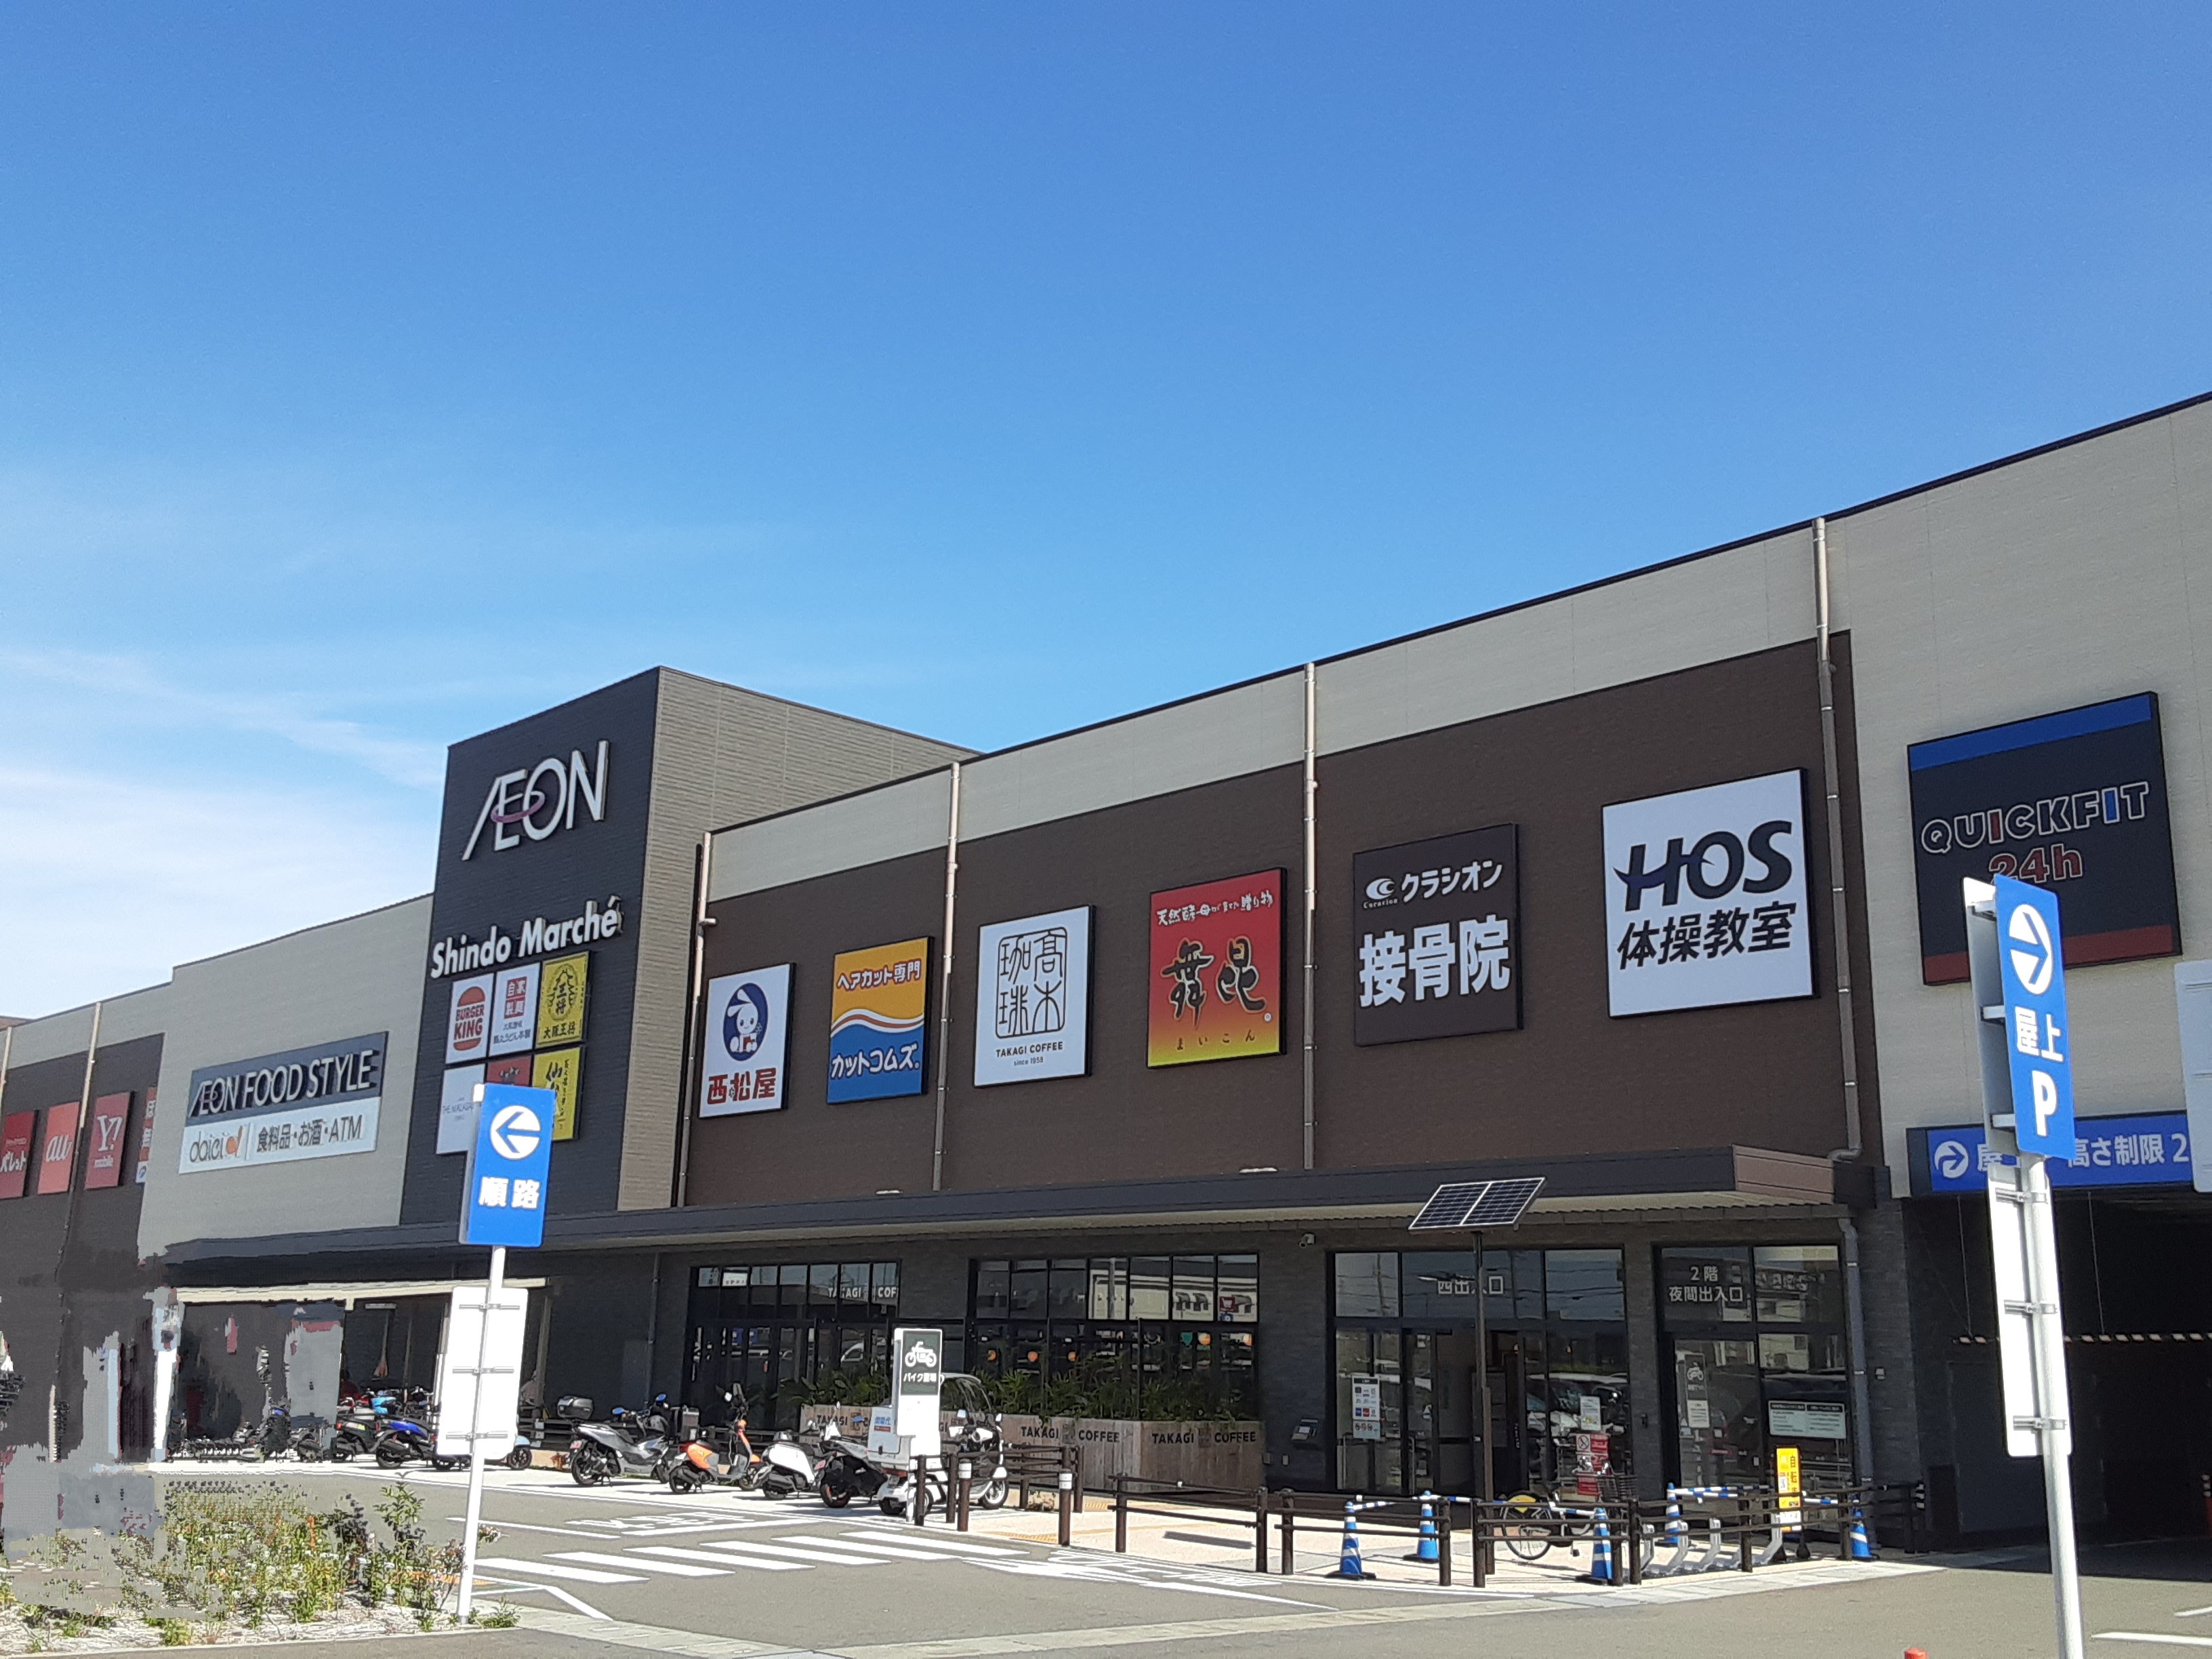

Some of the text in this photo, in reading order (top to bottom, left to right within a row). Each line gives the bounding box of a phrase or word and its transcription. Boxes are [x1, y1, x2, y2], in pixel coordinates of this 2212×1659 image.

[1921, 781, 2150, 854] QUICKFIT
[1401, 860, 1502, 903] クラシオン
[1612, 820, 1793, 912] HOS
[1988, 843, 2083, 885] 24h
[430, 895, 624, 977] Shindo Marché
[1617, 901, 1796, 970] 体操教室
[836, 960, 921, 990] ヘアカット専門
[1358, 915, 1511, 1008] 接骨院
[454, 1018, 483, 1040] KING
[543, 1021, 575, 1039] 大阪王将
[1176, 1029, 1256, 1050] まいこん
[2015, 1006, 2064, 1063] 屋上
[830, 1043, 918, 1080] カットコムズ
[996, 1041, 1063, 1057] TAKAGI COFFEE
[242, 1063, 303, 1108] FOOD
[306, 1049, 373, 1099] STYLE
[707, 1067, 777, 1105] 西松屋
[2032, 1069, 2057, 1137] P
[2068, 1132, 2166, 1168] 高さ制限
[478, 1176, 540, 1209] 順路
[1437, 1275, 1504, 1295] 西出口
[1690, 1265, 1719, 1282] 2階
[878, 1286, 899, 1298] COF
[1668, 1286, 1744, 1303] 夜間出入口
[1021, 1425, 1120, 1443] TAKAGI COFFEE
[1152, 1430, 1256, 1445] TAKAGI COFFEE
